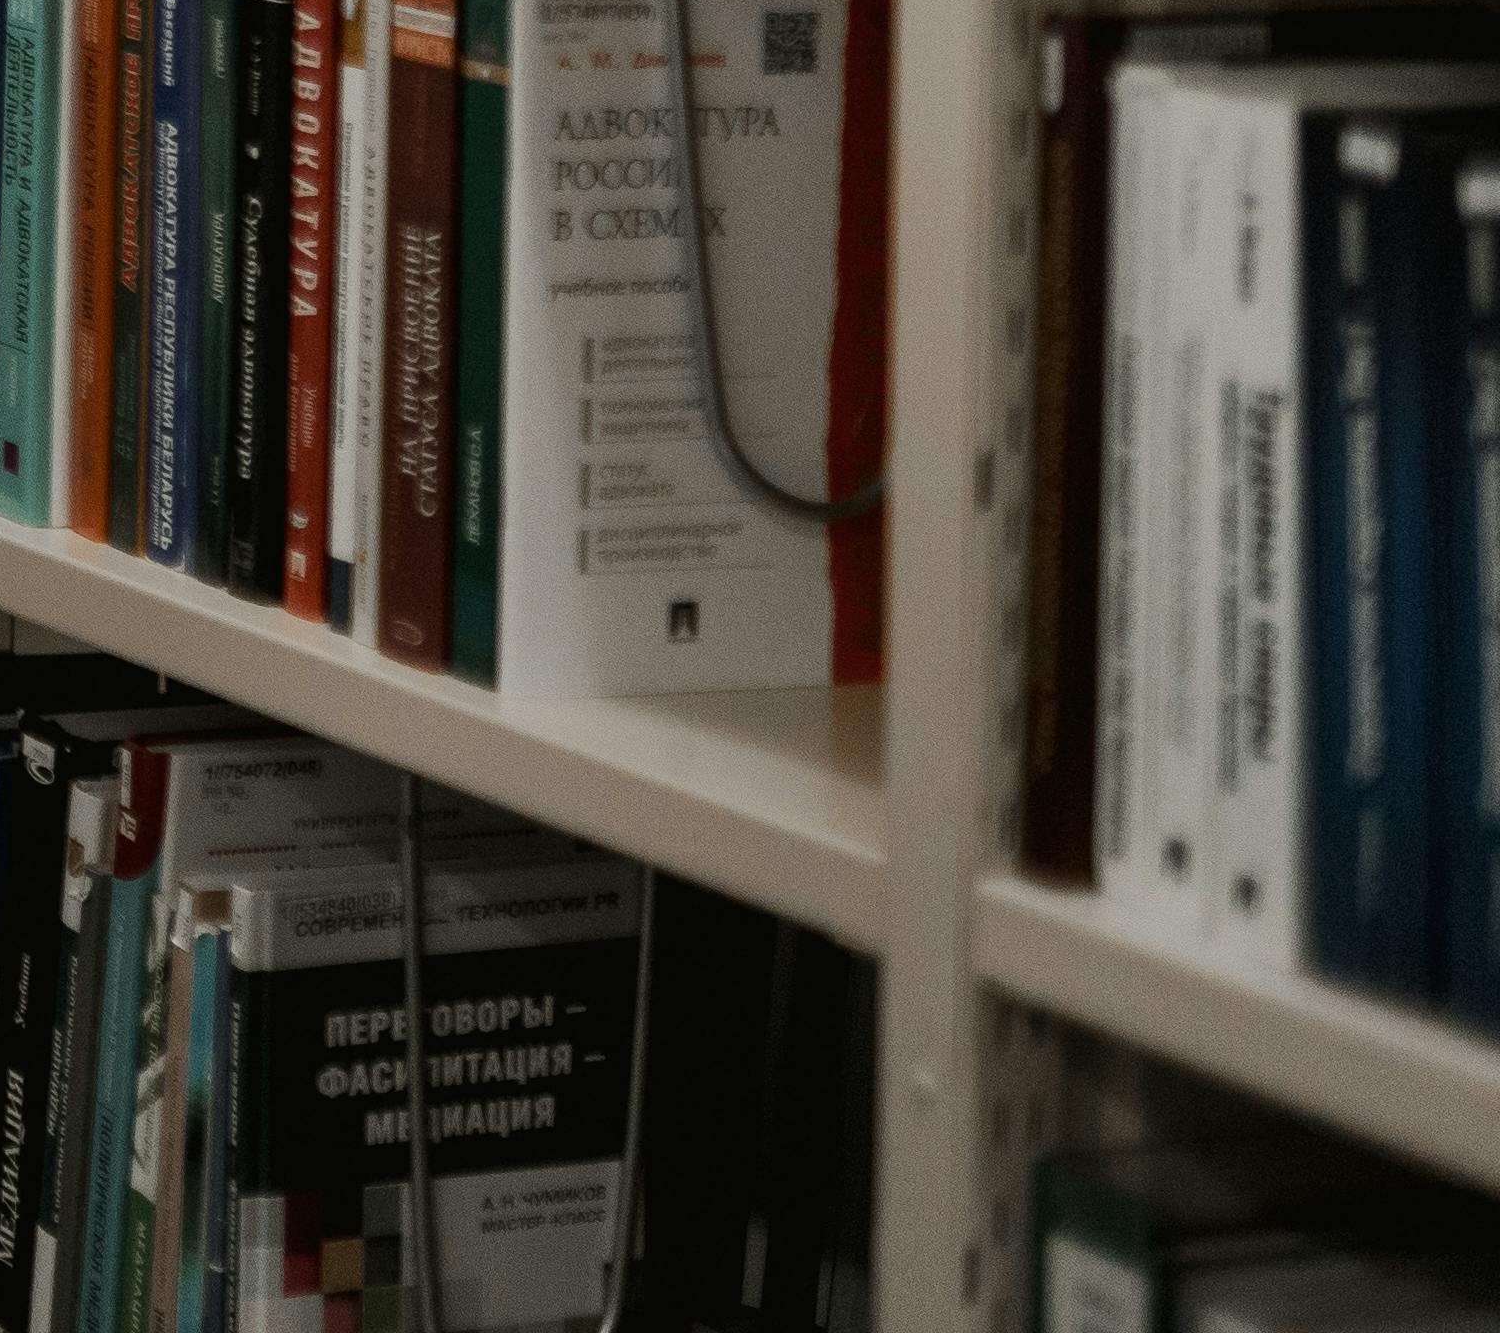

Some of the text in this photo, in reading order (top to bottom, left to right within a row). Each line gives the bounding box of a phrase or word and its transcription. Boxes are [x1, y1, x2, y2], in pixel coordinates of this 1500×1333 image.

[5, 33, 20, 187] ДЕЯТЕЛЬНОСТЬ
[14, 37, 36, 344] АДВОКАТУРА И АДВОКАТСКАЯ
[82, 56, 99, 322] АДВОКАТУРА РОССИИ
[121, 52, 143, 293] АДВОКАТСКОЕ
[290, 7, 323, 318] АДВОКАТУРА
[553, 158, 681, 191] РОССИ
[554, 107, 781, 142] АДВОКТУРА
[210, 210, 227, 305] АДВОКАТУРА
[552, 207, 726, 242] В СХЕМХ
[160, 123, 179, 551] АДВОКАТУРА РЕСПУБЛИКИ БЕЛАРУСЬ
[234, 195, 263, 481] Судебная адвокатура
[400, 226, 422, 478] НА ПРИСВОЕНИЕ
[416, 231, 443, 519] СТАТУСА АДВОКАТА
[12, 952, 31, 1029] Учебник
[47, 1028, 62, 1138] МЕДИАЦИЯ
[324, 993, 555, 1050] ПЕРЕОВОРЫ
